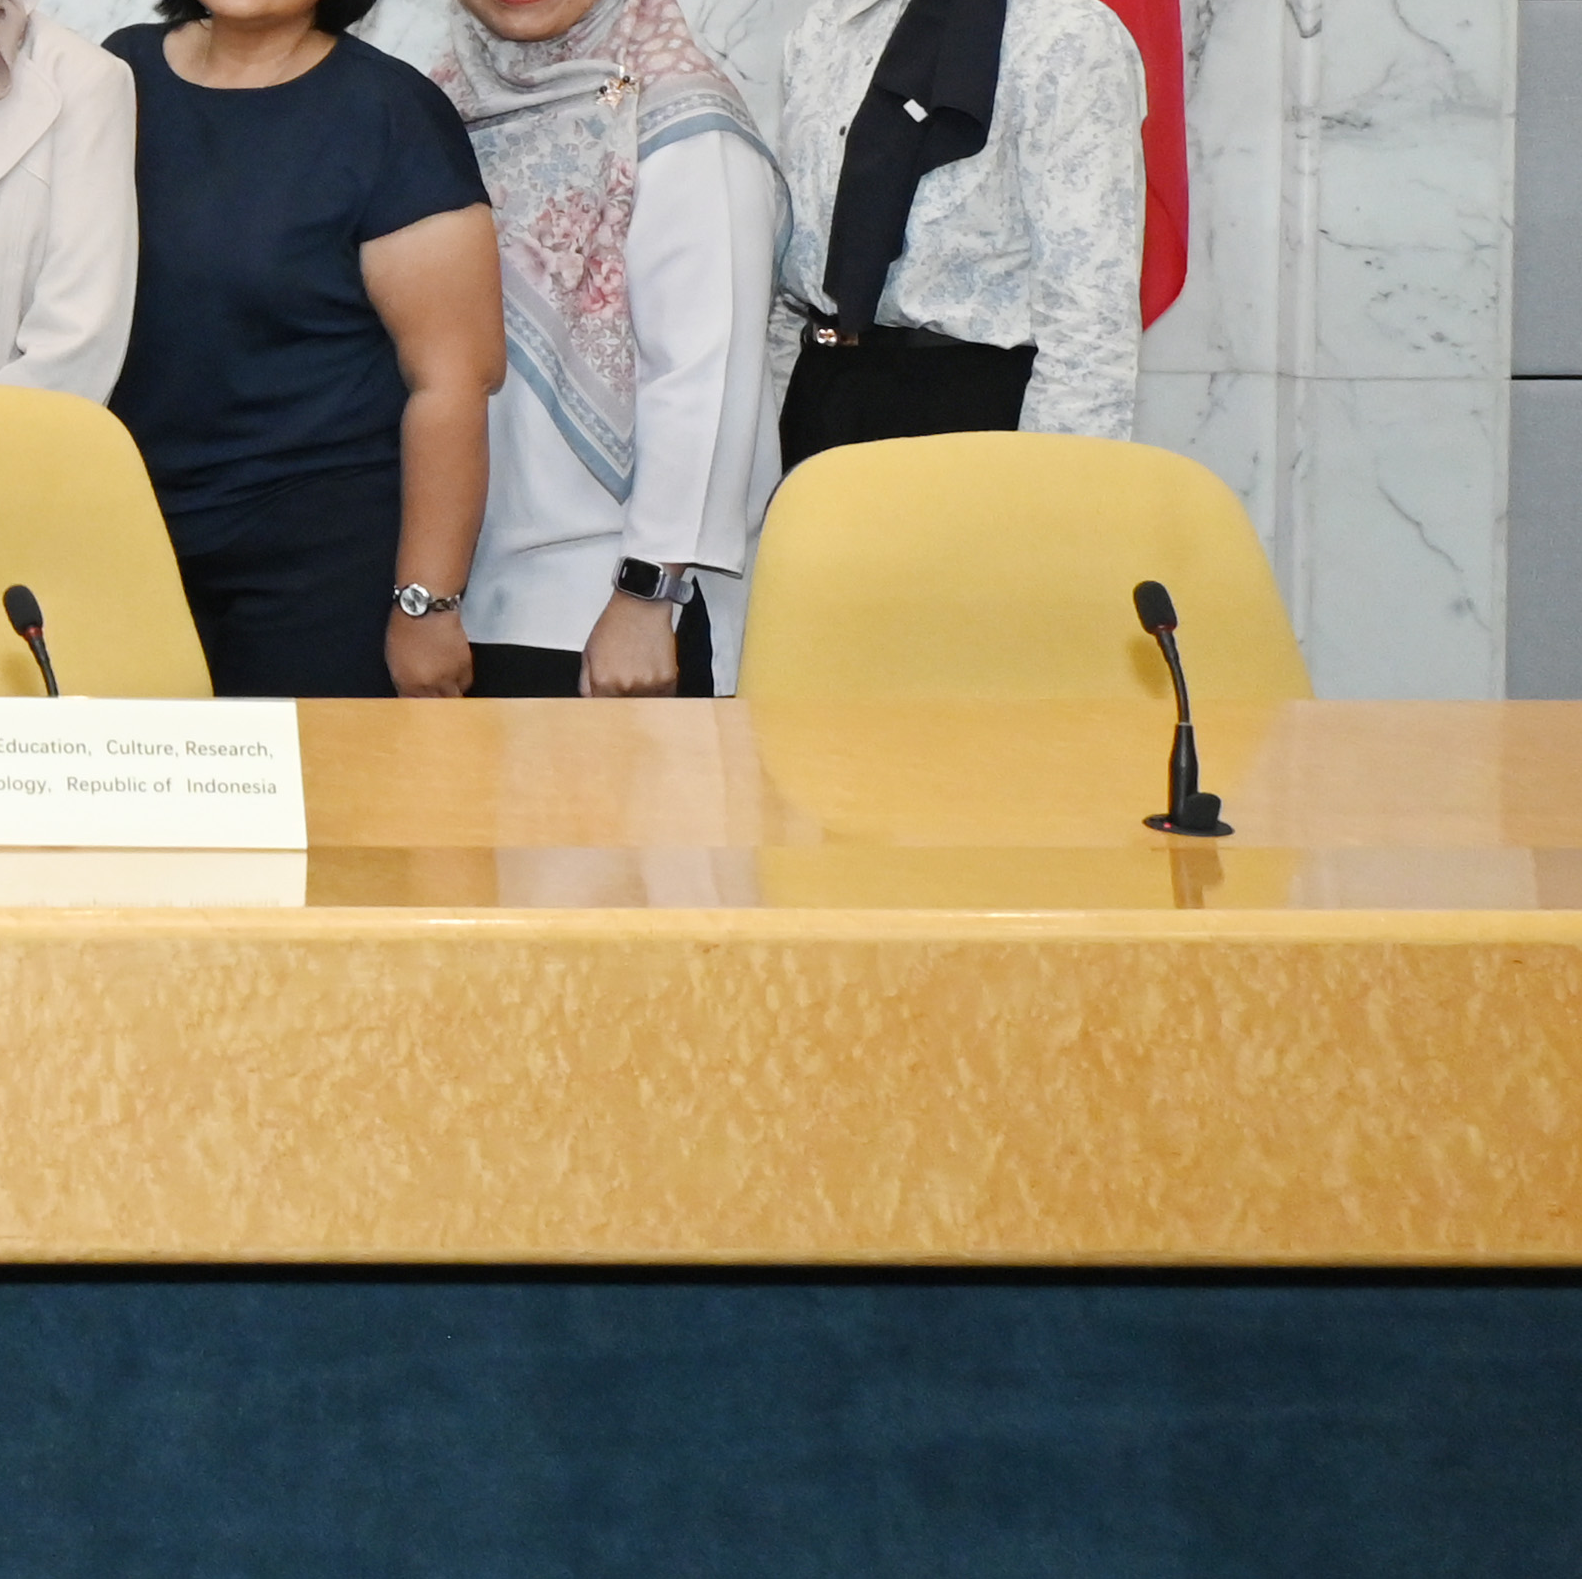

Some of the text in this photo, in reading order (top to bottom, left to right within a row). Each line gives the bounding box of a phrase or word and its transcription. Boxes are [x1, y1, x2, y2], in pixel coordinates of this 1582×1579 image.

[106, 739, 179, 758] Culture,
[185, 740, 274, 759] Research,
[66, 776, 147, 795] Republic
[153, 777, 172, 793] of
[187, 778, 277, 795] Indonesia
